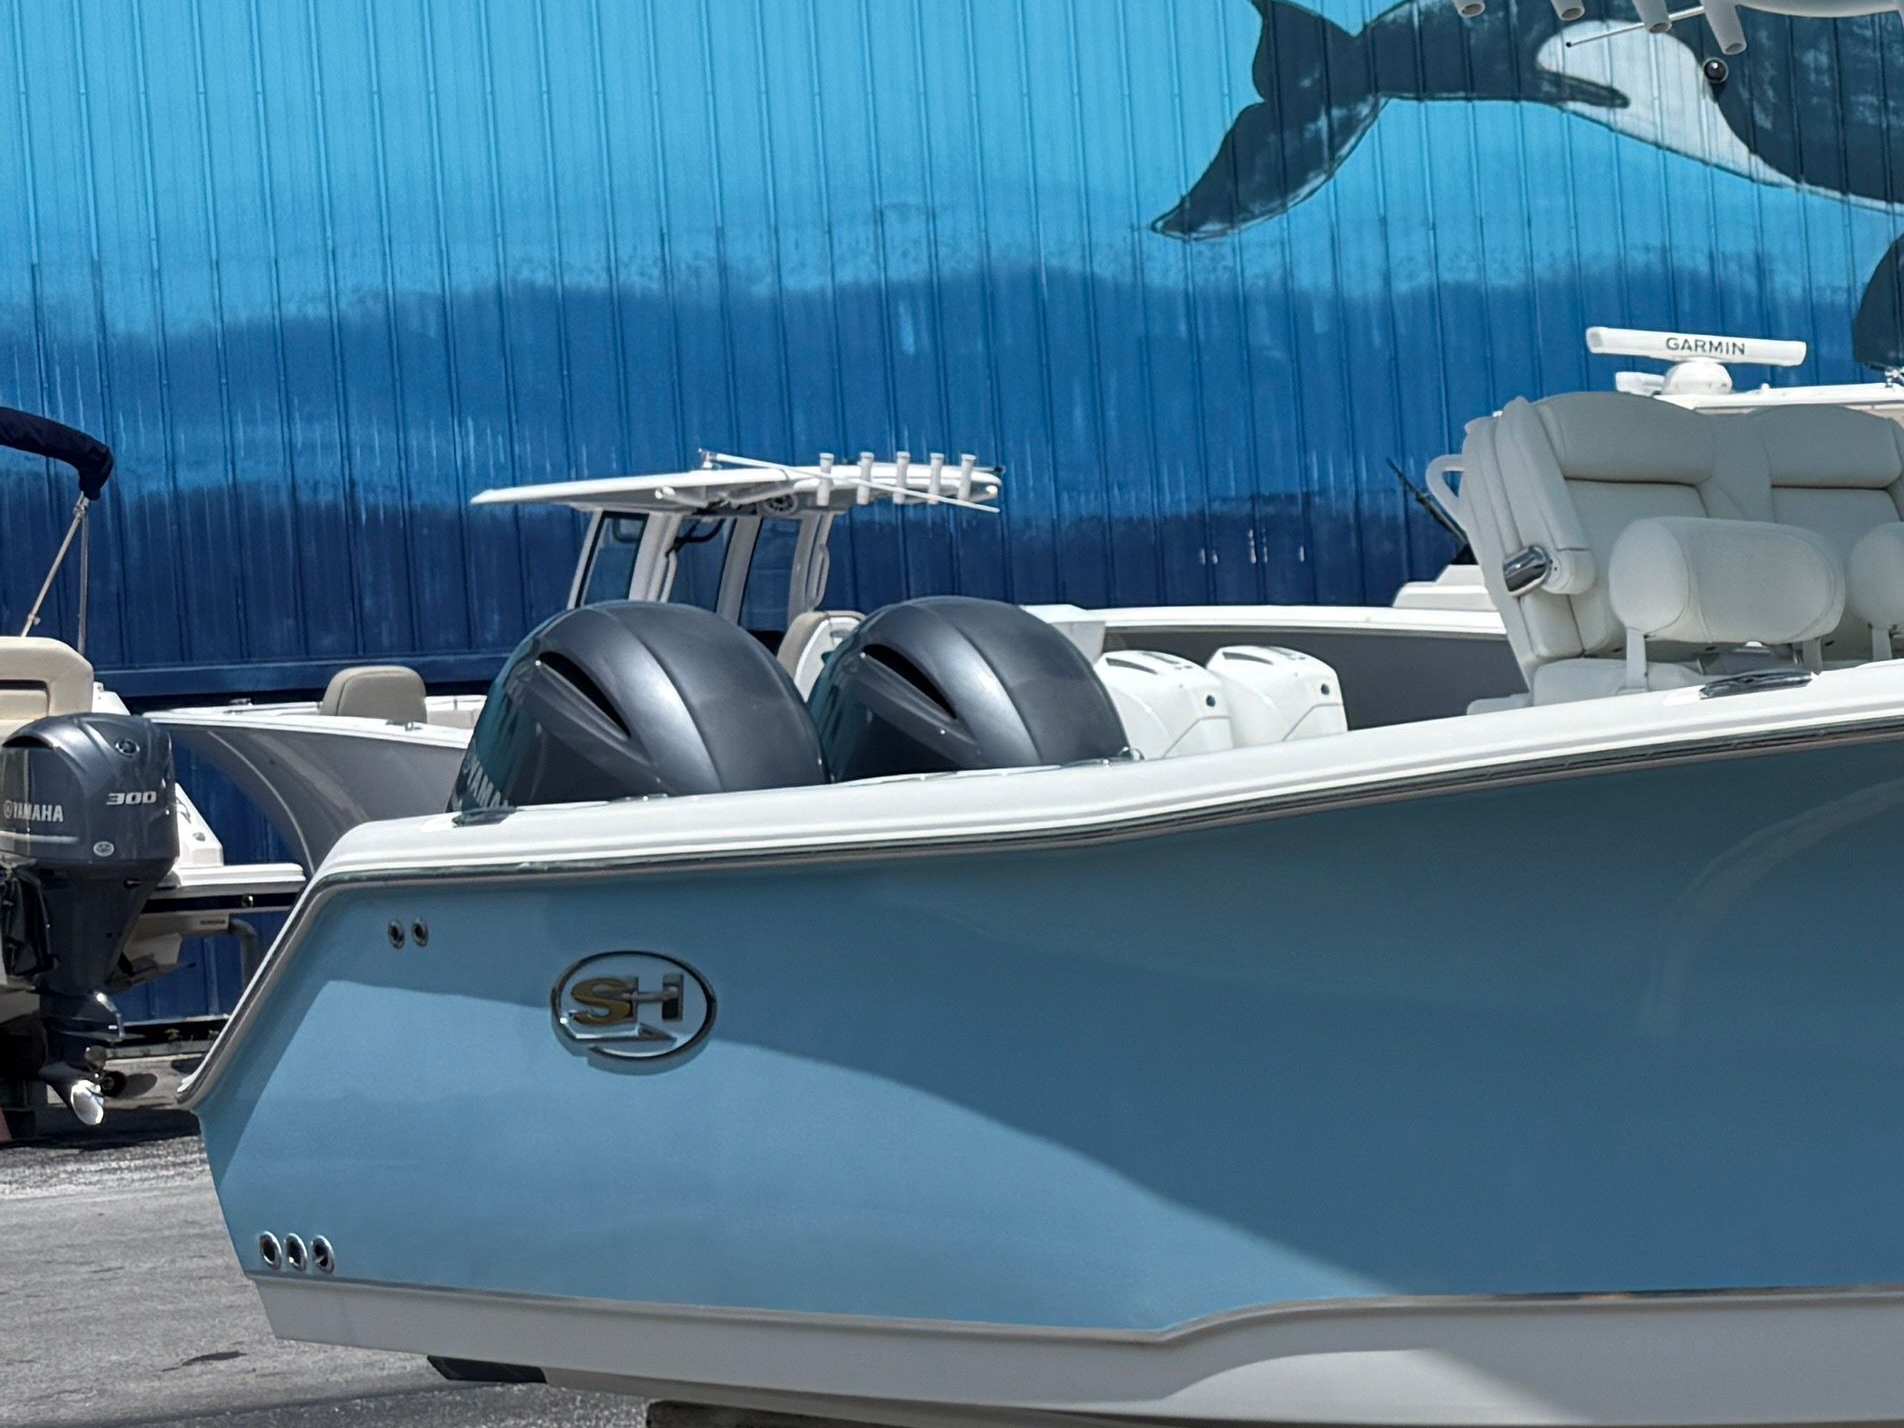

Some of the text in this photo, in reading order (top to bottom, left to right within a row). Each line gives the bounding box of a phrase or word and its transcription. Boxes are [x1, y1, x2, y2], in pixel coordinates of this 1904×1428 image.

[1665, 337, 1745, 355] GARMIN
[106, 790, 157, 806] 300
[13, 803, 64, 823] YAMAHA
